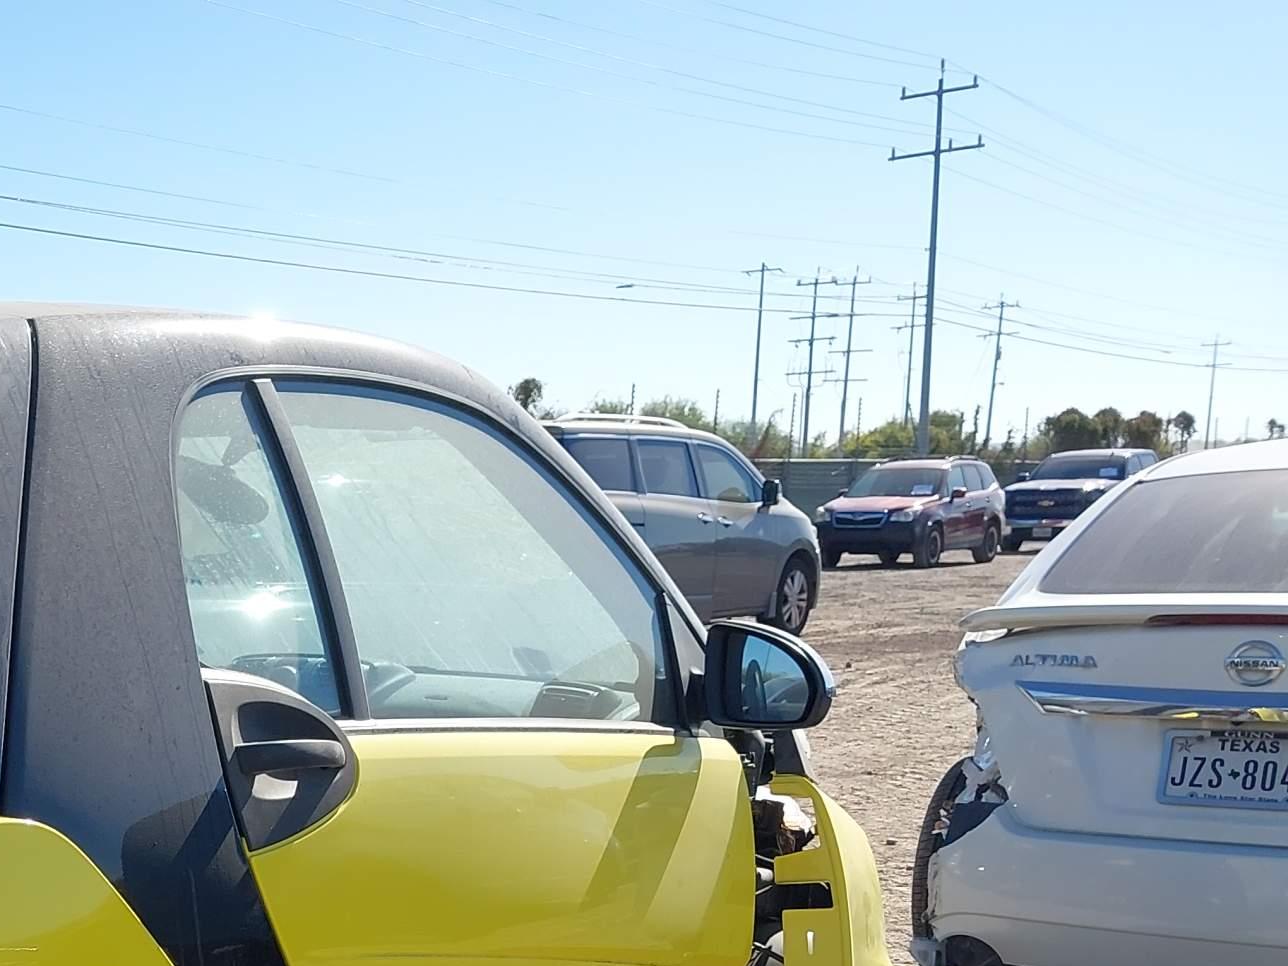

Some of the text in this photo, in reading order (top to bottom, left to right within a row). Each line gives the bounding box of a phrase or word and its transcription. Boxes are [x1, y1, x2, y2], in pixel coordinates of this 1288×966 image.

[1009, 654, 1098, 668] ALTIMA
[1230, 659, 1279, 668] NISSAN
[1218, 738, 1281, 754] TEXAS
